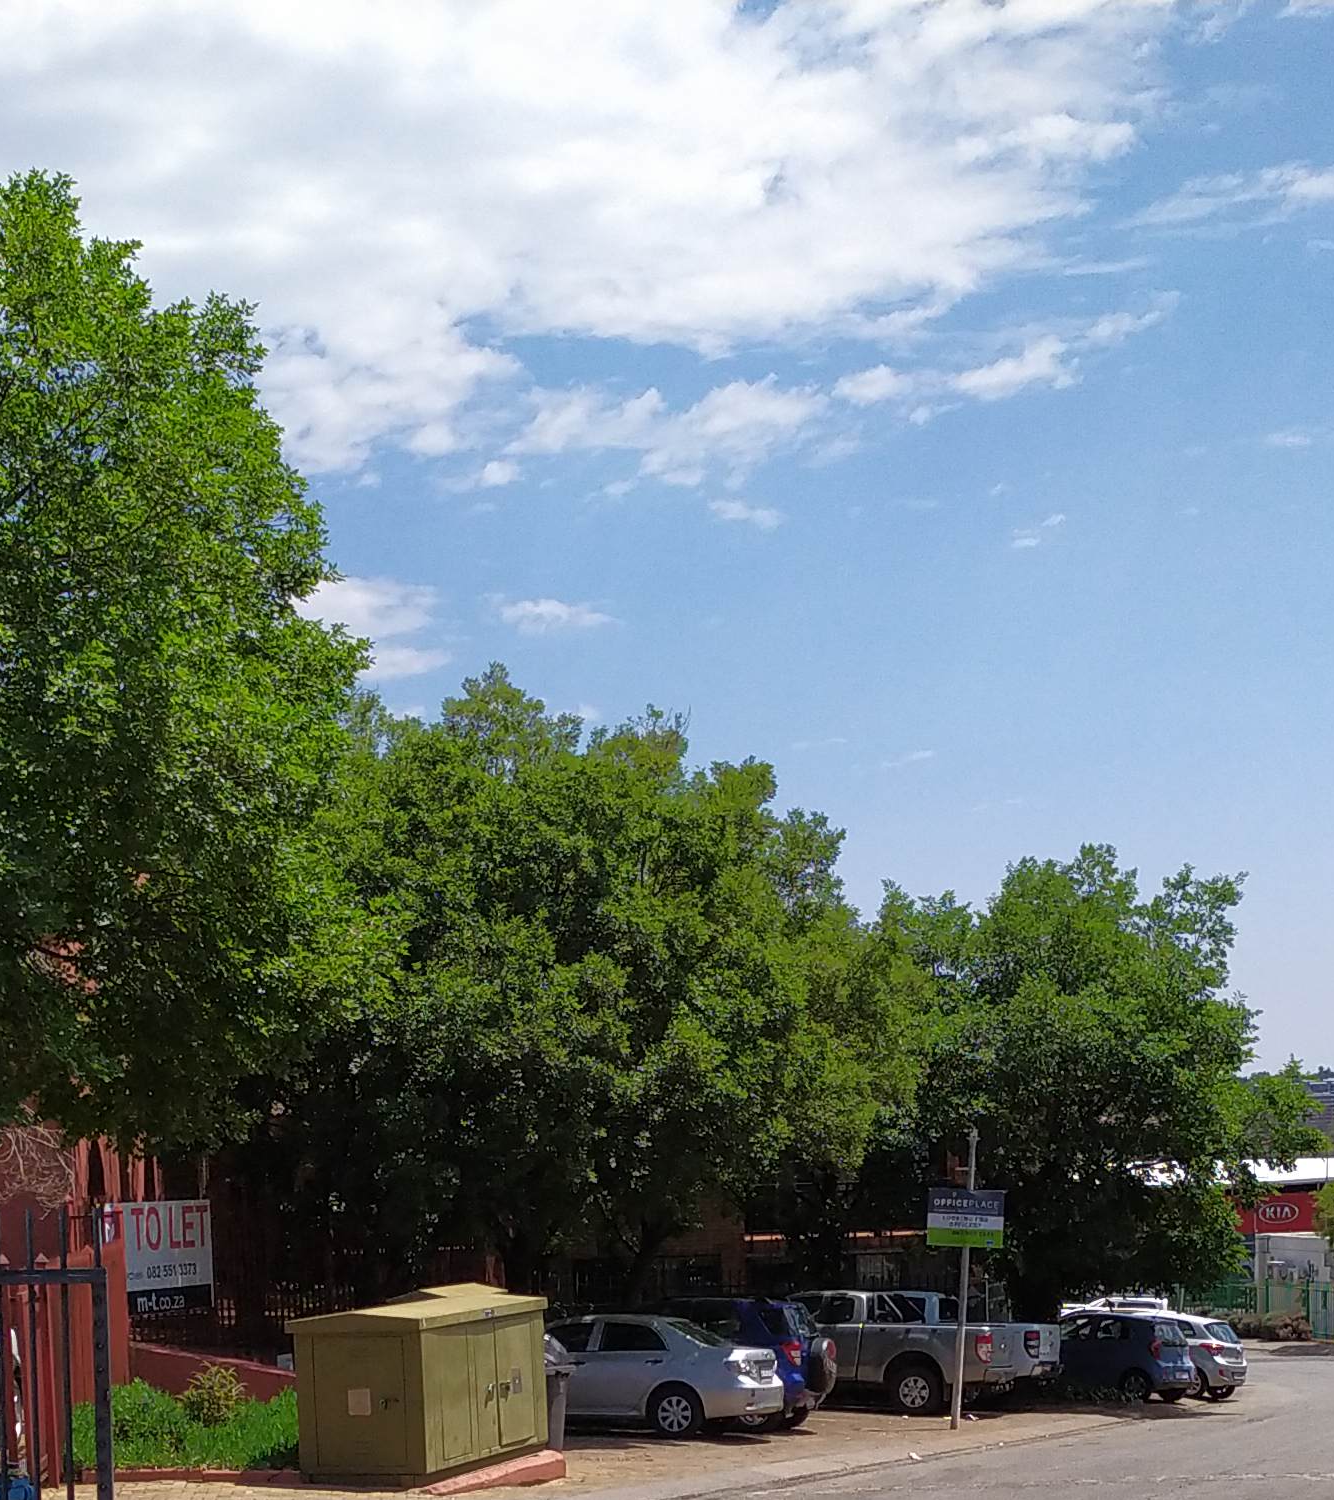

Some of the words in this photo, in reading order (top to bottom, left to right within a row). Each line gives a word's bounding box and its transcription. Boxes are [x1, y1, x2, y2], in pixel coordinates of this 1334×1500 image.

[1266, 1206, 1292, 1219] KIA
[131, 1205, 163, 1251] TO
[169, 1204, 208, 1249] LET
[147, 1266, 161, 1279] 082
[163, 1264, 177, 1277] 551
[178, 1263, 197, 1276] 3373
